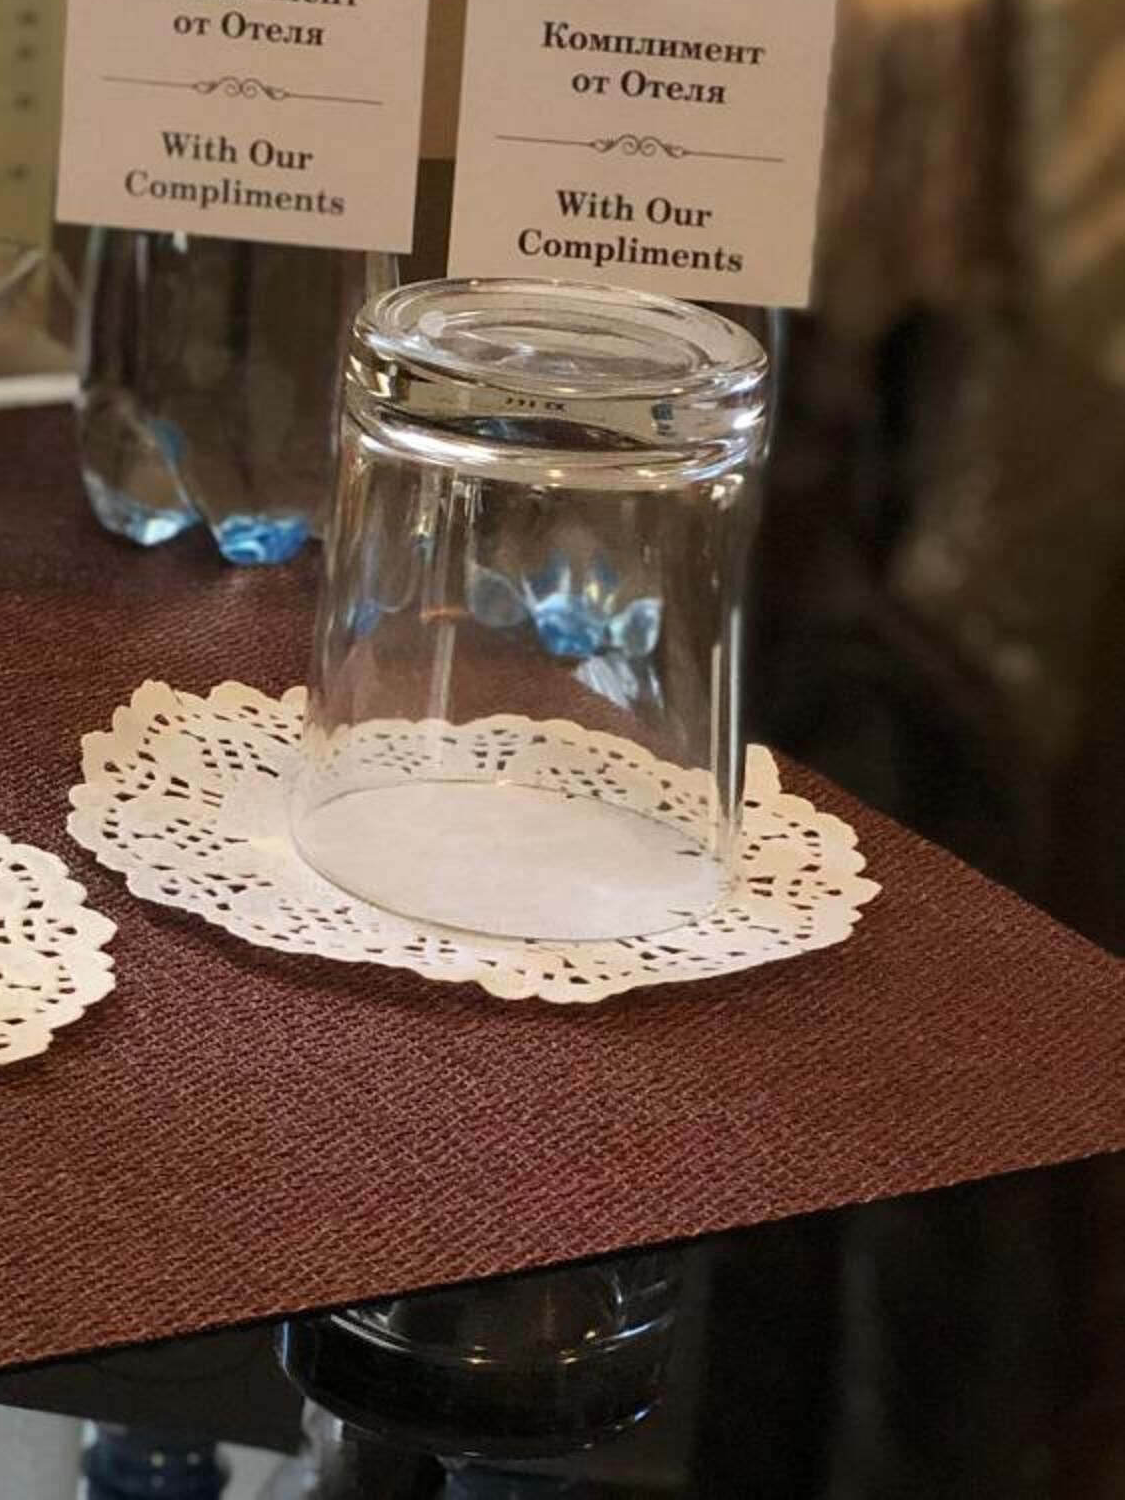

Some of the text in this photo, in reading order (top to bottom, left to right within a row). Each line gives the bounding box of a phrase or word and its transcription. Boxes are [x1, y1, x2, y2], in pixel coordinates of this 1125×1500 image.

[173, 10, 325, 47] от Отеля
[541, 20, 767, 66] Комплимент
[571, 68, 727, 105] от Отеля
[161, 130, 315, 172] With Our
[124, 168, 346, 216] Compliments
[556, 188, 714, 229] With Our
[516, 227, 745, 274] Compliments
